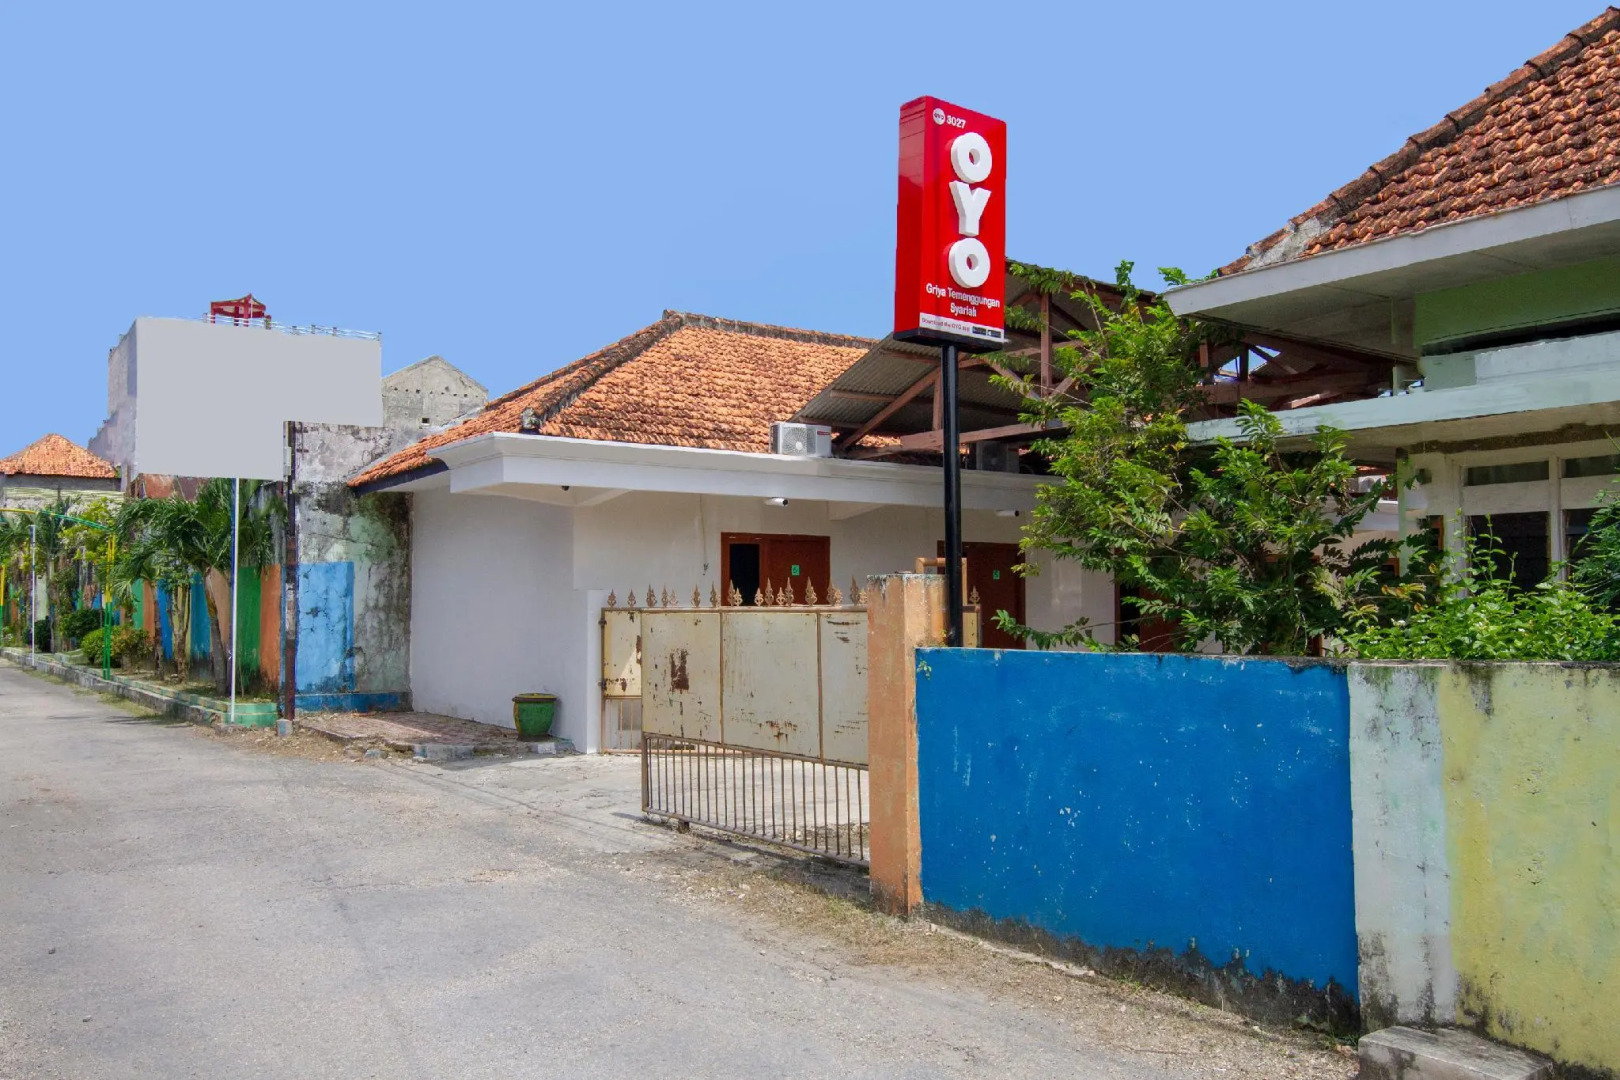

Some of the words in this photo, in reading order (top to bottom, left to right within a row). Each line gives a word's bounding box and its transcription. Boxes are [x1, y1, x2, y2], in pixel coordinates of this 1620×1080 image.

[947, 115, 966, 129] 3027
[949, 132, 992, 288] OYO
[926, 283, 946, 298] Griya
[948, 287, 1000, 308] Temenggungan
[950, 302, 977, 317] Syariah
